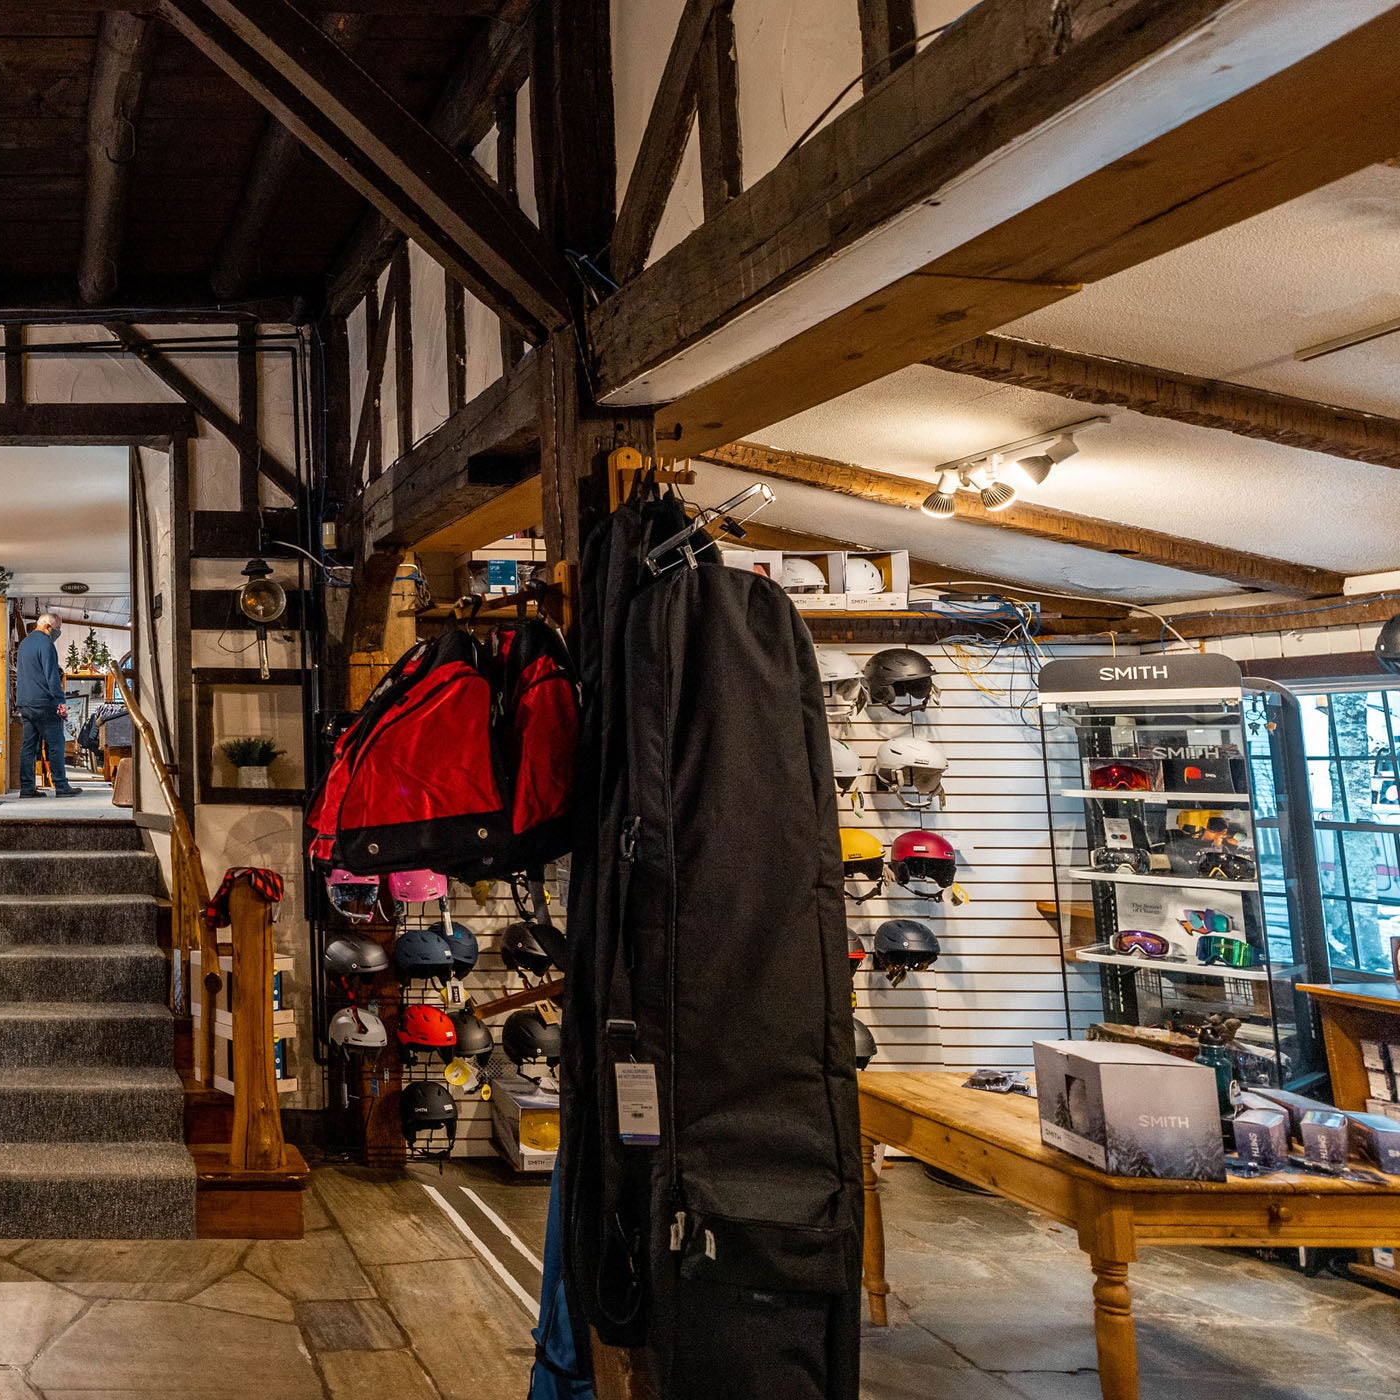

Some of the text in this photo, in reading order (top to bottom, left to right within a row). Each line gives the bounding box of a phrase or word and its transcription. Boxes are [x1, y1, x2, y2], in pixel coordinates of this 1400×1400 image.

[1100, 666, 1168, 681] SMITH
[1139, 1115, 1190, 1129] SMITH
[1044, 1127, 1063, 1142] SMITH
[1248, 1133, 1260, 1157] SMITH
[1317, 1135, 1329, 1159] SMITH
